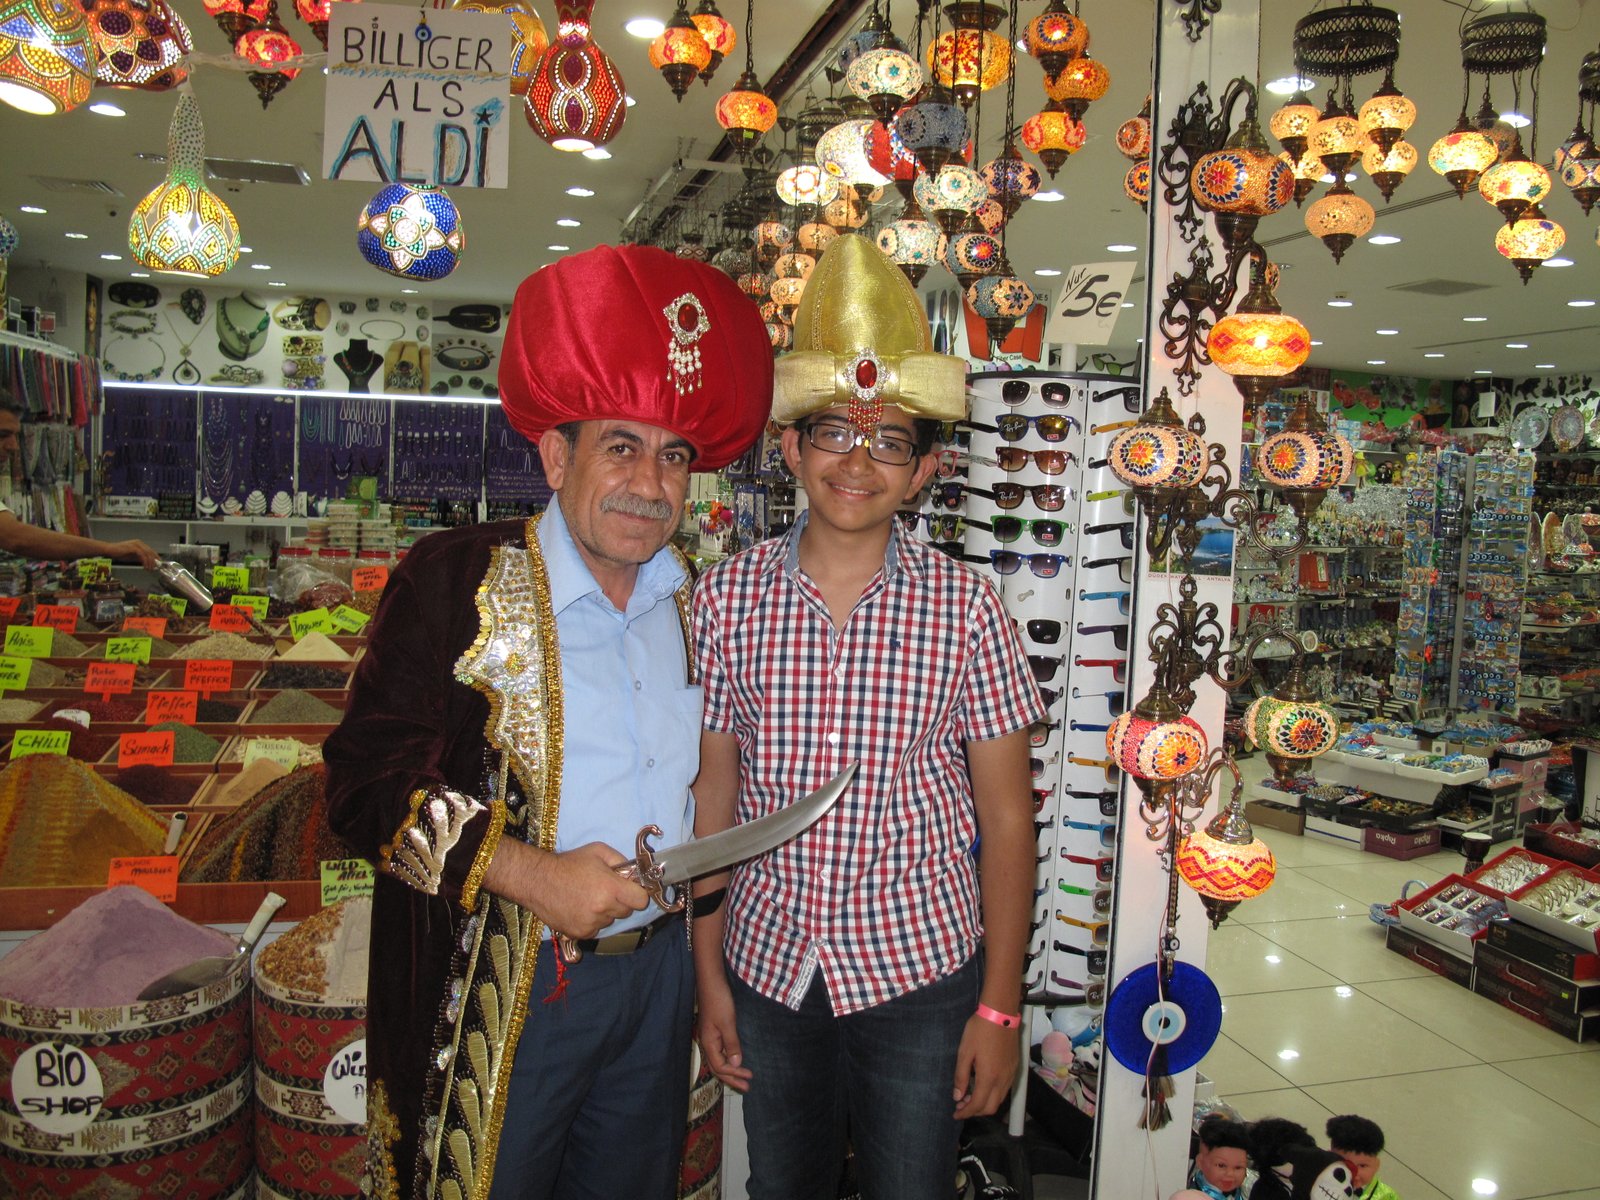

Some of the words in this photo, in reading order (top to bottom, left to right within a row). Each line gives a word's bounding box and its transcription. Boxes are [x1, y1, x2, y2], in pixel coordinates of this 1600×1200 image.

[373, 78, 465, 118] ALS
[1065, 267, 1087, 293] Nur
[8, 631, 35, 647] Anis
[21, 1096, 103, 1116] SHOP
